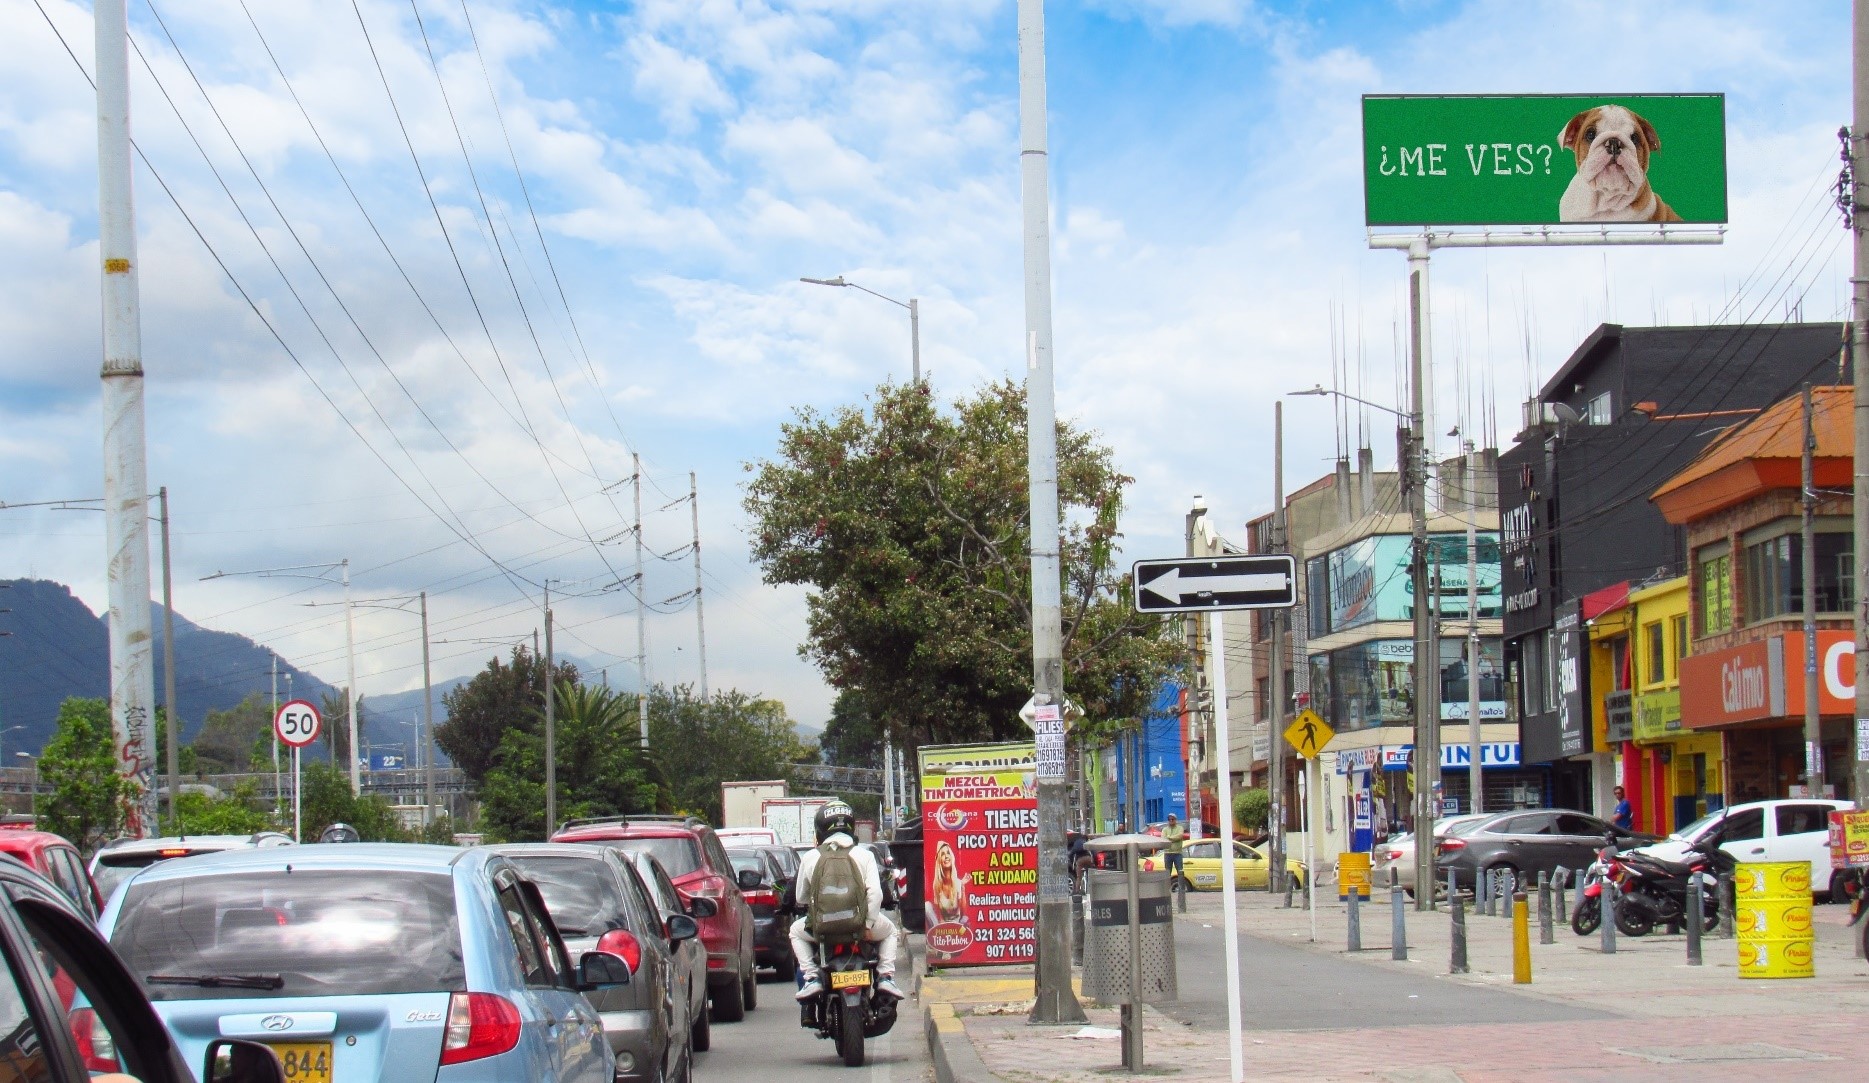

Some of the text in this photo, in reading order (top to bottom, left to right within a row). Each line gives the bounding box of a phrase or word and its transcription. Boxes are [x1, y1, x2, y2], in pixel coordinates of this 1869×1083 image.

[1380, 144, 1553, 176] ¿ME VES?
[285, 712, 313, 735] 50
[383, 755, 396, 767] 22
[1389, 753, 1409, 762] BLE
[944, 775, 998, 788] MEZCLA
[923, 786, 1022, 800] TINTOMETRICA
[984, 808, 1039, 830] TIENES
[956, 834, 988, 849] PICO
[989, 833, 999, 848] Y
[989, 851, 1024, 867] A QUI
[971, 871, 986, 885] TE
[969, 893, 1001, 906] Realiza
[1002, 893, 1012, 905] tu
[977, 910, 985, 922] A
[974, 928, 993, 941] 321
[997, 927, 1016, 940] 324
[986, 943, 1034, 958] 907 1119
[832, 972, 869, 985] ZLG-89F
[405, 1009, 441, 1022] Getz
[283, 1051, 329, 1078] 844
